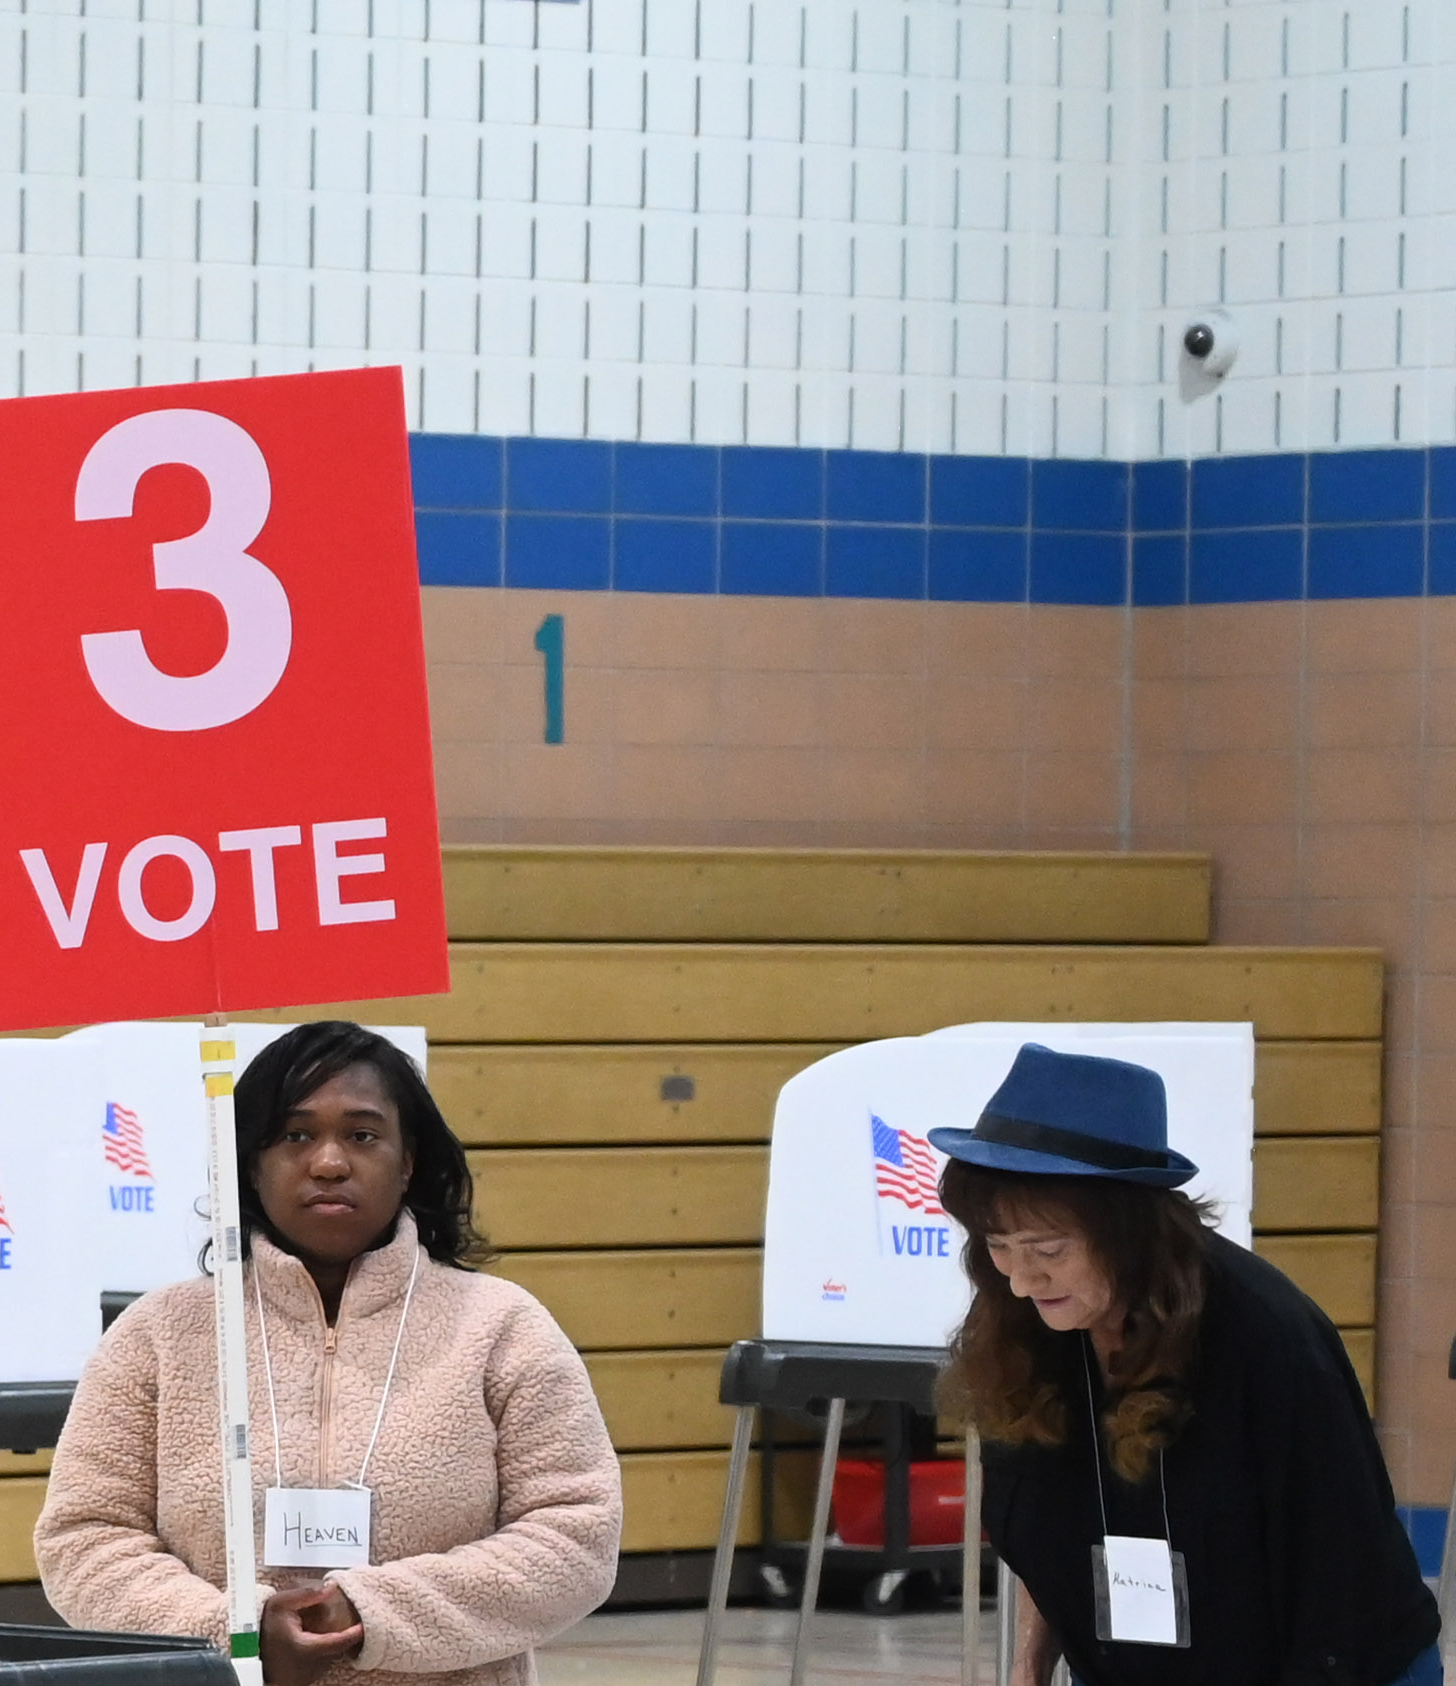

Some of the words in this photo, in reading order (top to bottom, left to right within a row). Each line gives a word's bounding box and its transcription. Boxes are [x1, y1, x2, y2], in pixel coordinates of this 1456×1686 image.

[74, 408, 292, 732] 3
[535, 613, 564, 744] 1
[19, 817, 396, 949] VOTE
[109, 1186, 155, 1212] VOTE
[892, 1225, 950, 1257] VOTE
[284, 1511, 362, 1550] HEAVEN
